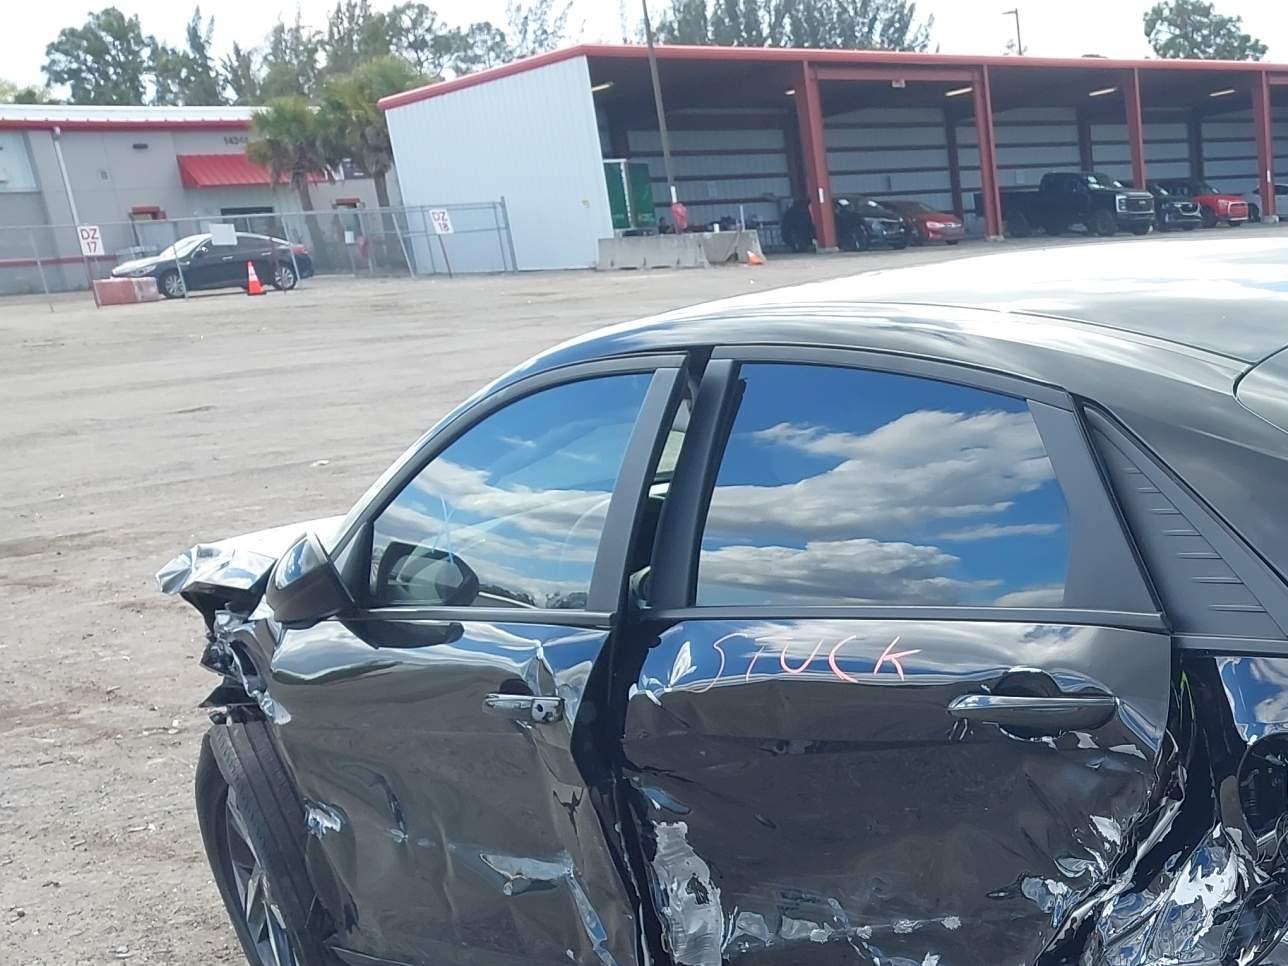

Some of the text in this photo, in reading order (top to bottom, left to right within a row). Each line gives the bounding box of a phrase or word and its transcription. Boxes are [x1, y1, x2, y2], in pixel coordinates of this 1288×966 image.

[432, 211, 448, 222] DZ
[80, 228, 99, 240] DZ
[86, 241, 97, 253] 17
[690, 632, 921, 693] STUCK
